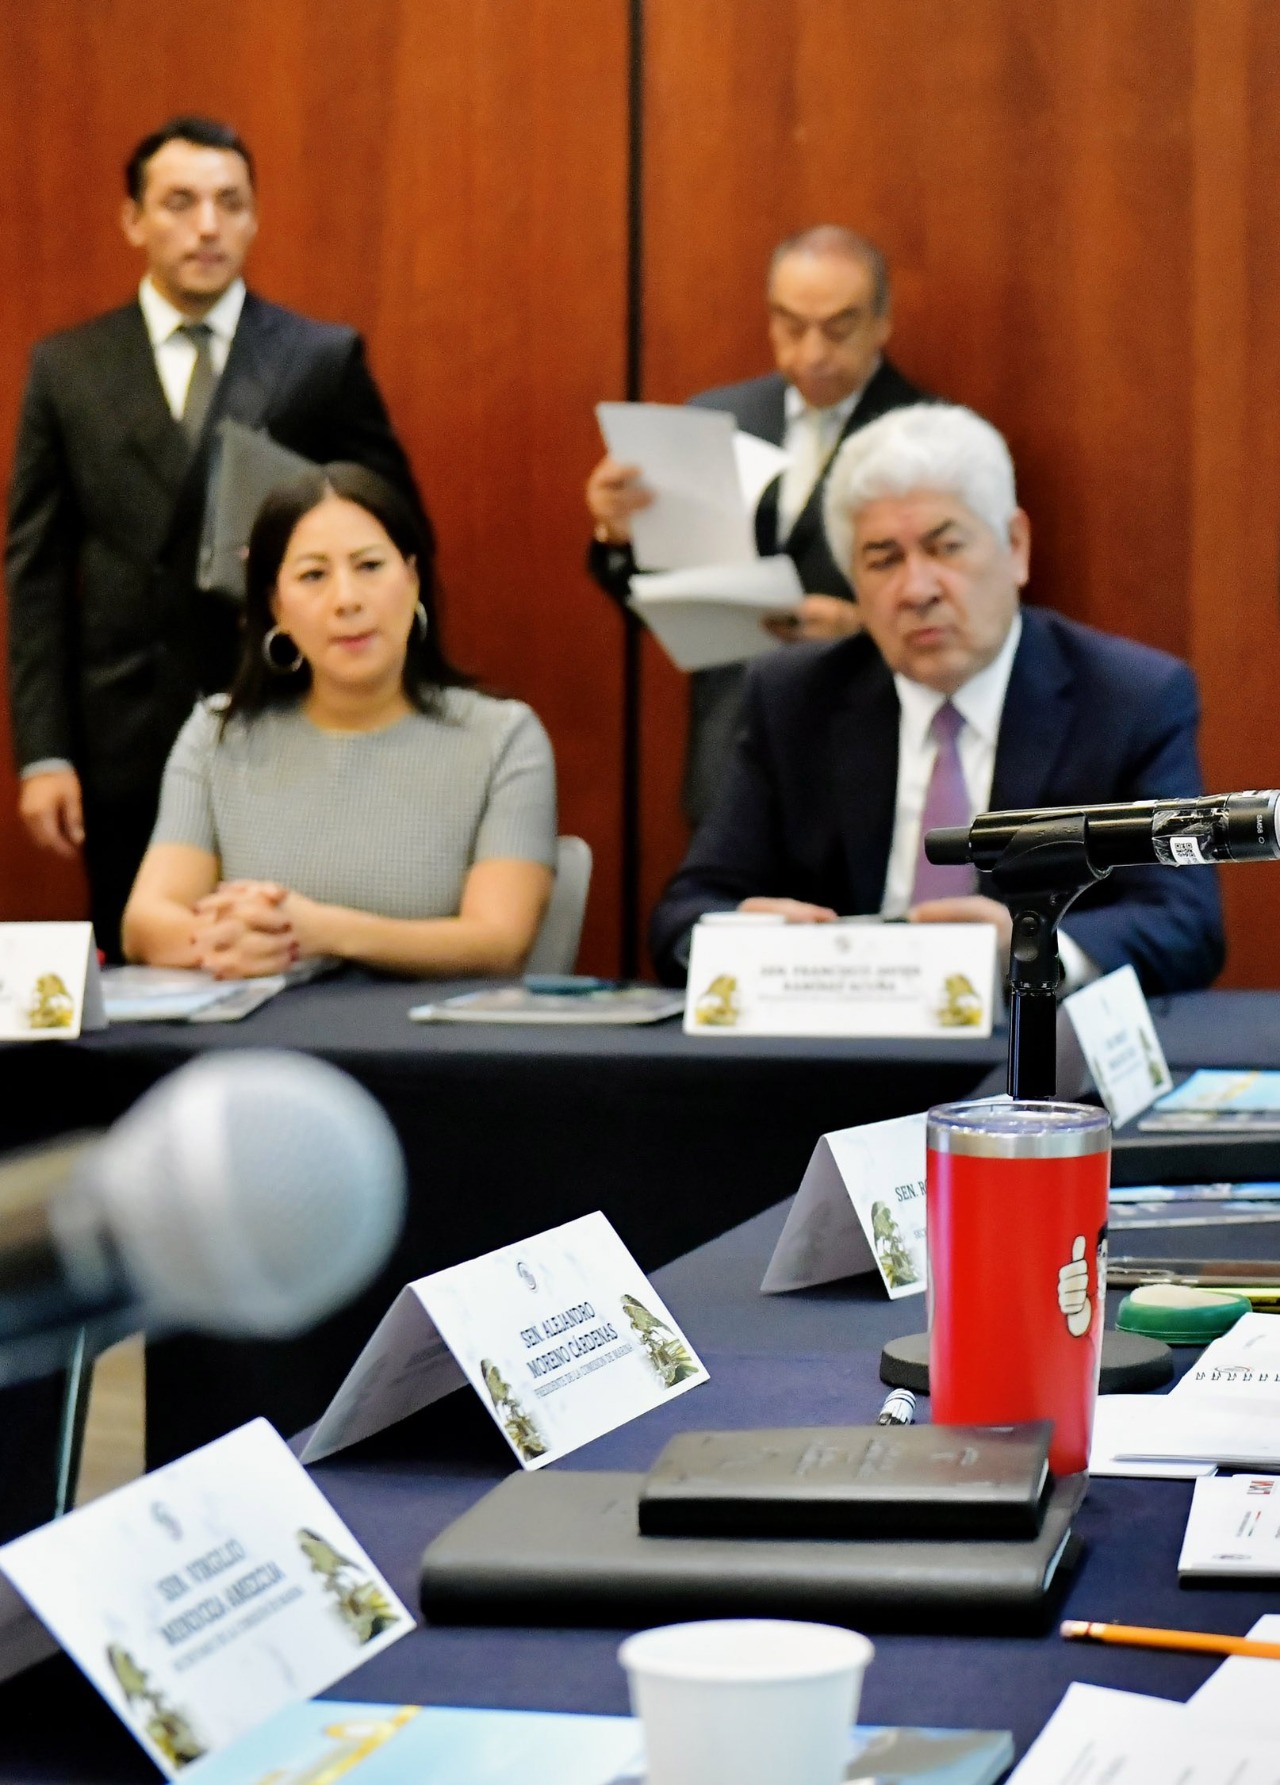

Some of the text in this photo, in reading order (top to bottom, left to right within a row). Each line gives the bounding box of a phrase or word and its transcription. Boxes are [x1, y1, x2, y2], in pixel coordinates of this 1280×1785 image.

[895, 1184, 919, 1202] SEN.
[542, 1302, 596, 1339] ALEJANDRO
[526, 1322, 619, 1378] MORENO CÁRDENAS
